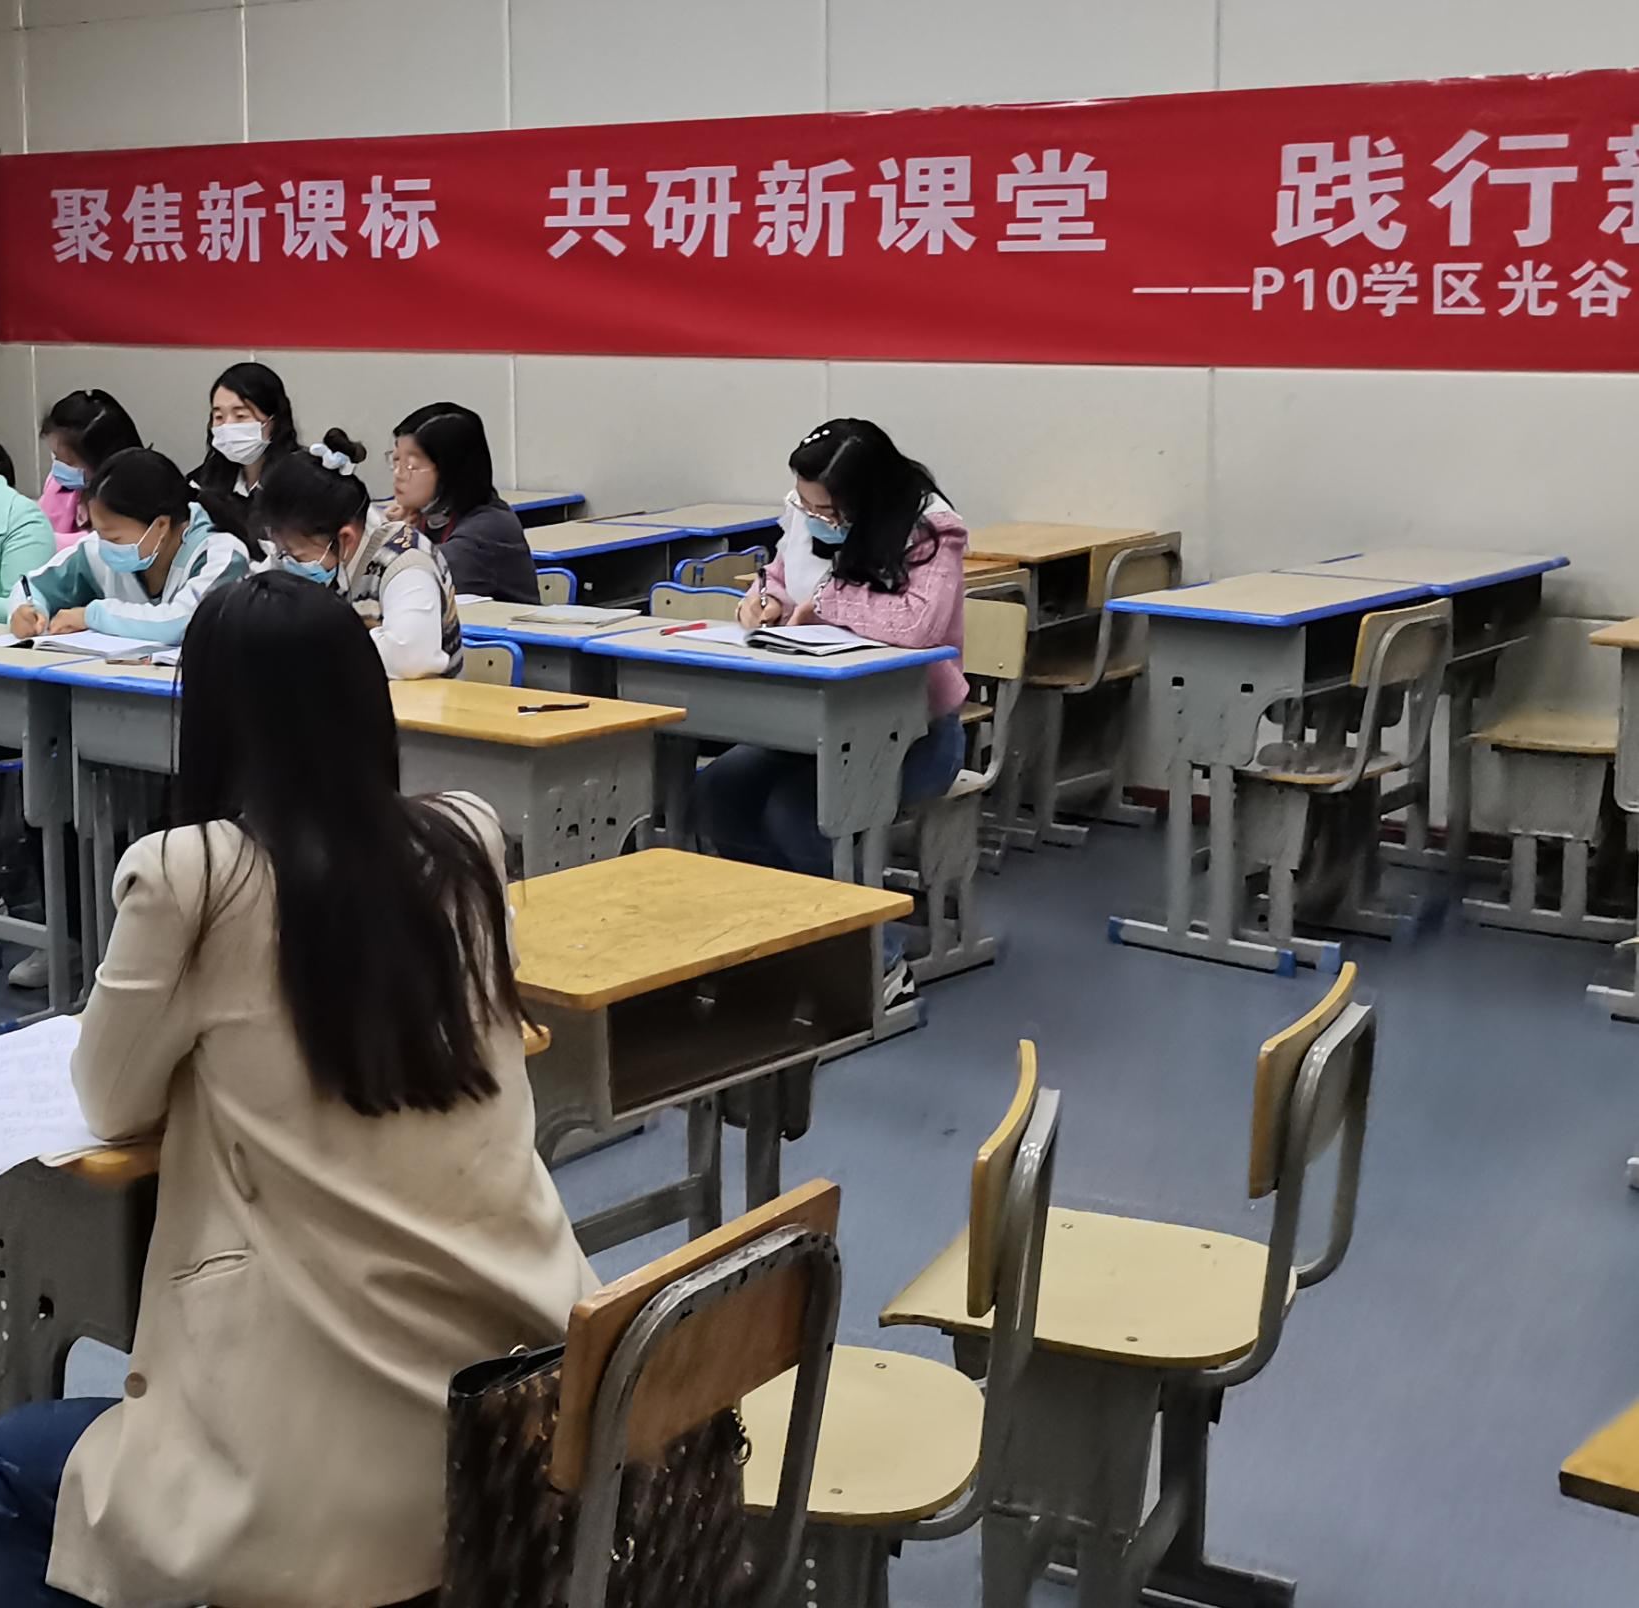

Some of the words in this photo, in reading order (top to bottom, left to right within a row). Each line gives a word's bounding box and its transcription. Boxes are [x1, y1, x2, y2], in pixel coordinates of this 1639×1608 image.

[51, 175, 440, 263] 聚焦新课标
[544, 148, 1108, 259] 共研新课堂
[1271, 123, 1639, 250] 践行
